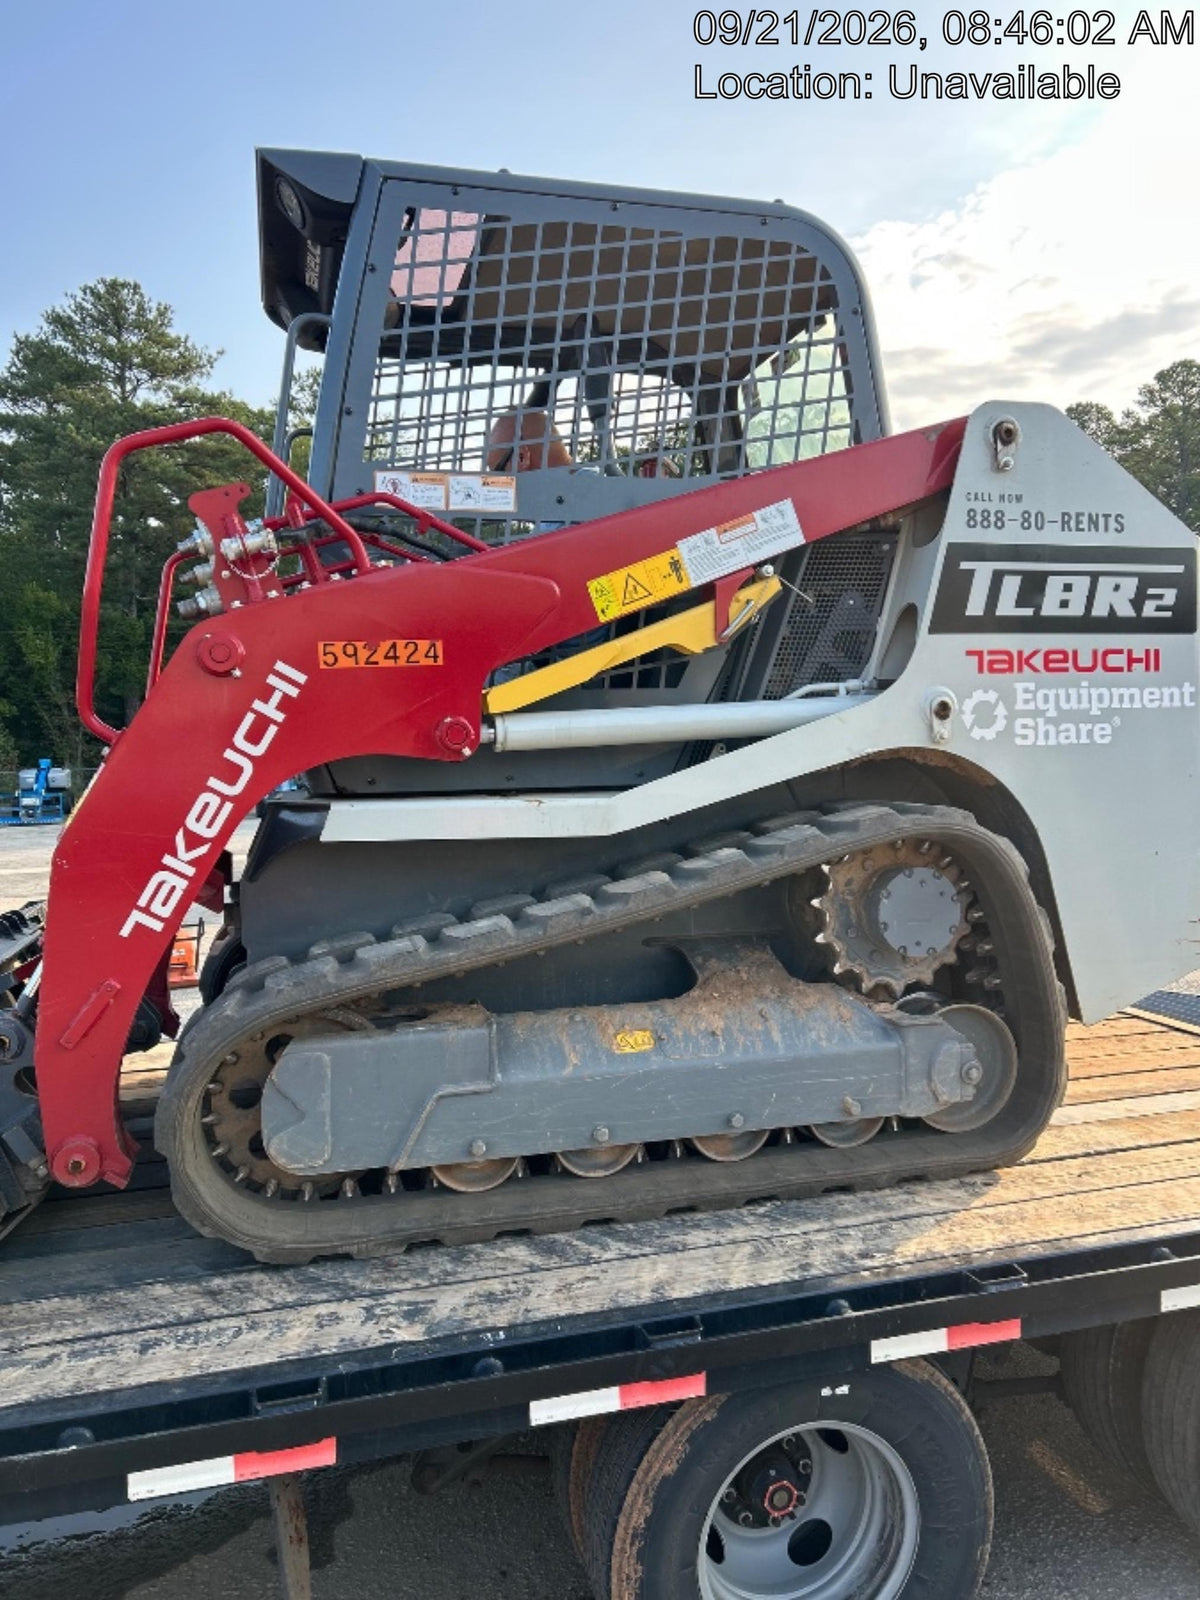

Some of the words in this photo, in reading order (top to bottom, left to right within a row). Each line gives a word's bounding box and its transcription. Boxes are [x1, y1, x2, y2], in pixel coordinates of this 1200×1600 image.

[965, 492, 993, 502] CALL
[966, 508, 1125, 534] 888-80-RENTS
[322, 641, 439, 667] 592424
[1014, 682, 1196, 716] Equipment
